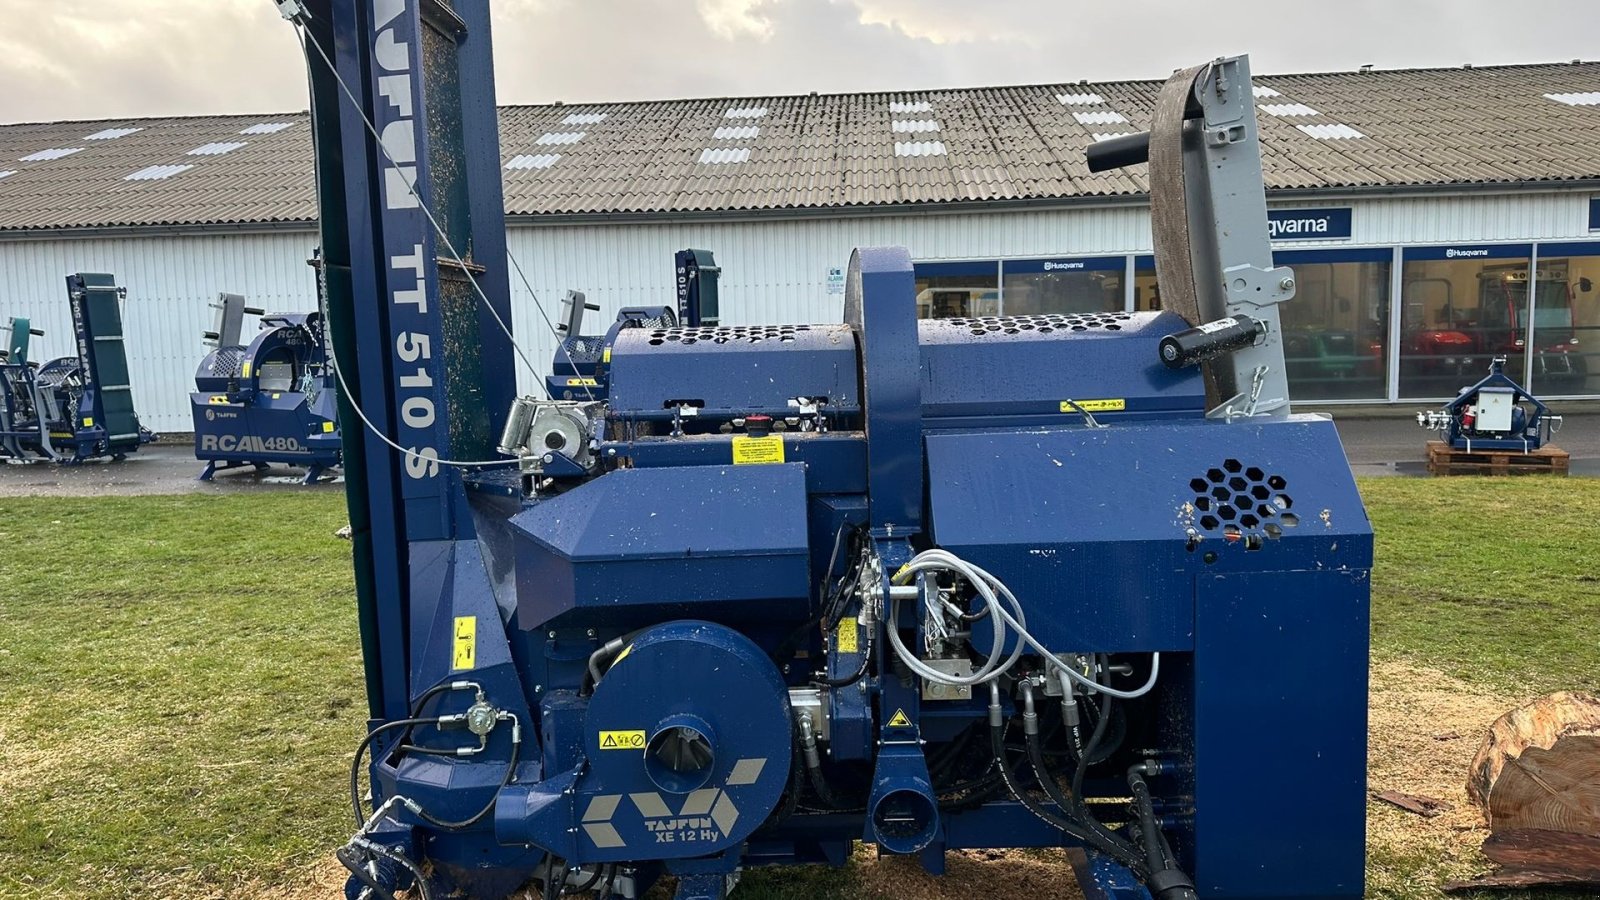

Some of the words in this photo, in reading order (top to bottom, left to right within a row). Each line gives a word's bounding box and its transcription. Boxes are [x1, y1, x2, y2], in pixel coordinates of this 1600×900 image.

[1453, 249, 1488, 257] Husqvarna
[391, 244, 428, 314] TT
[678, 277, 687, 295] 510
[680, 298, 688, 311] TT
[397, 331, 435, 429] 510
[265, 437, 298, 451] 480
[405, 446, 439, 479] S
[644, 817, 711, 831] TAJFUN
[656, 831, 675, 843] XE
[680, 830, 696, 842] 12
[700, 829, 719, 842] Hy
